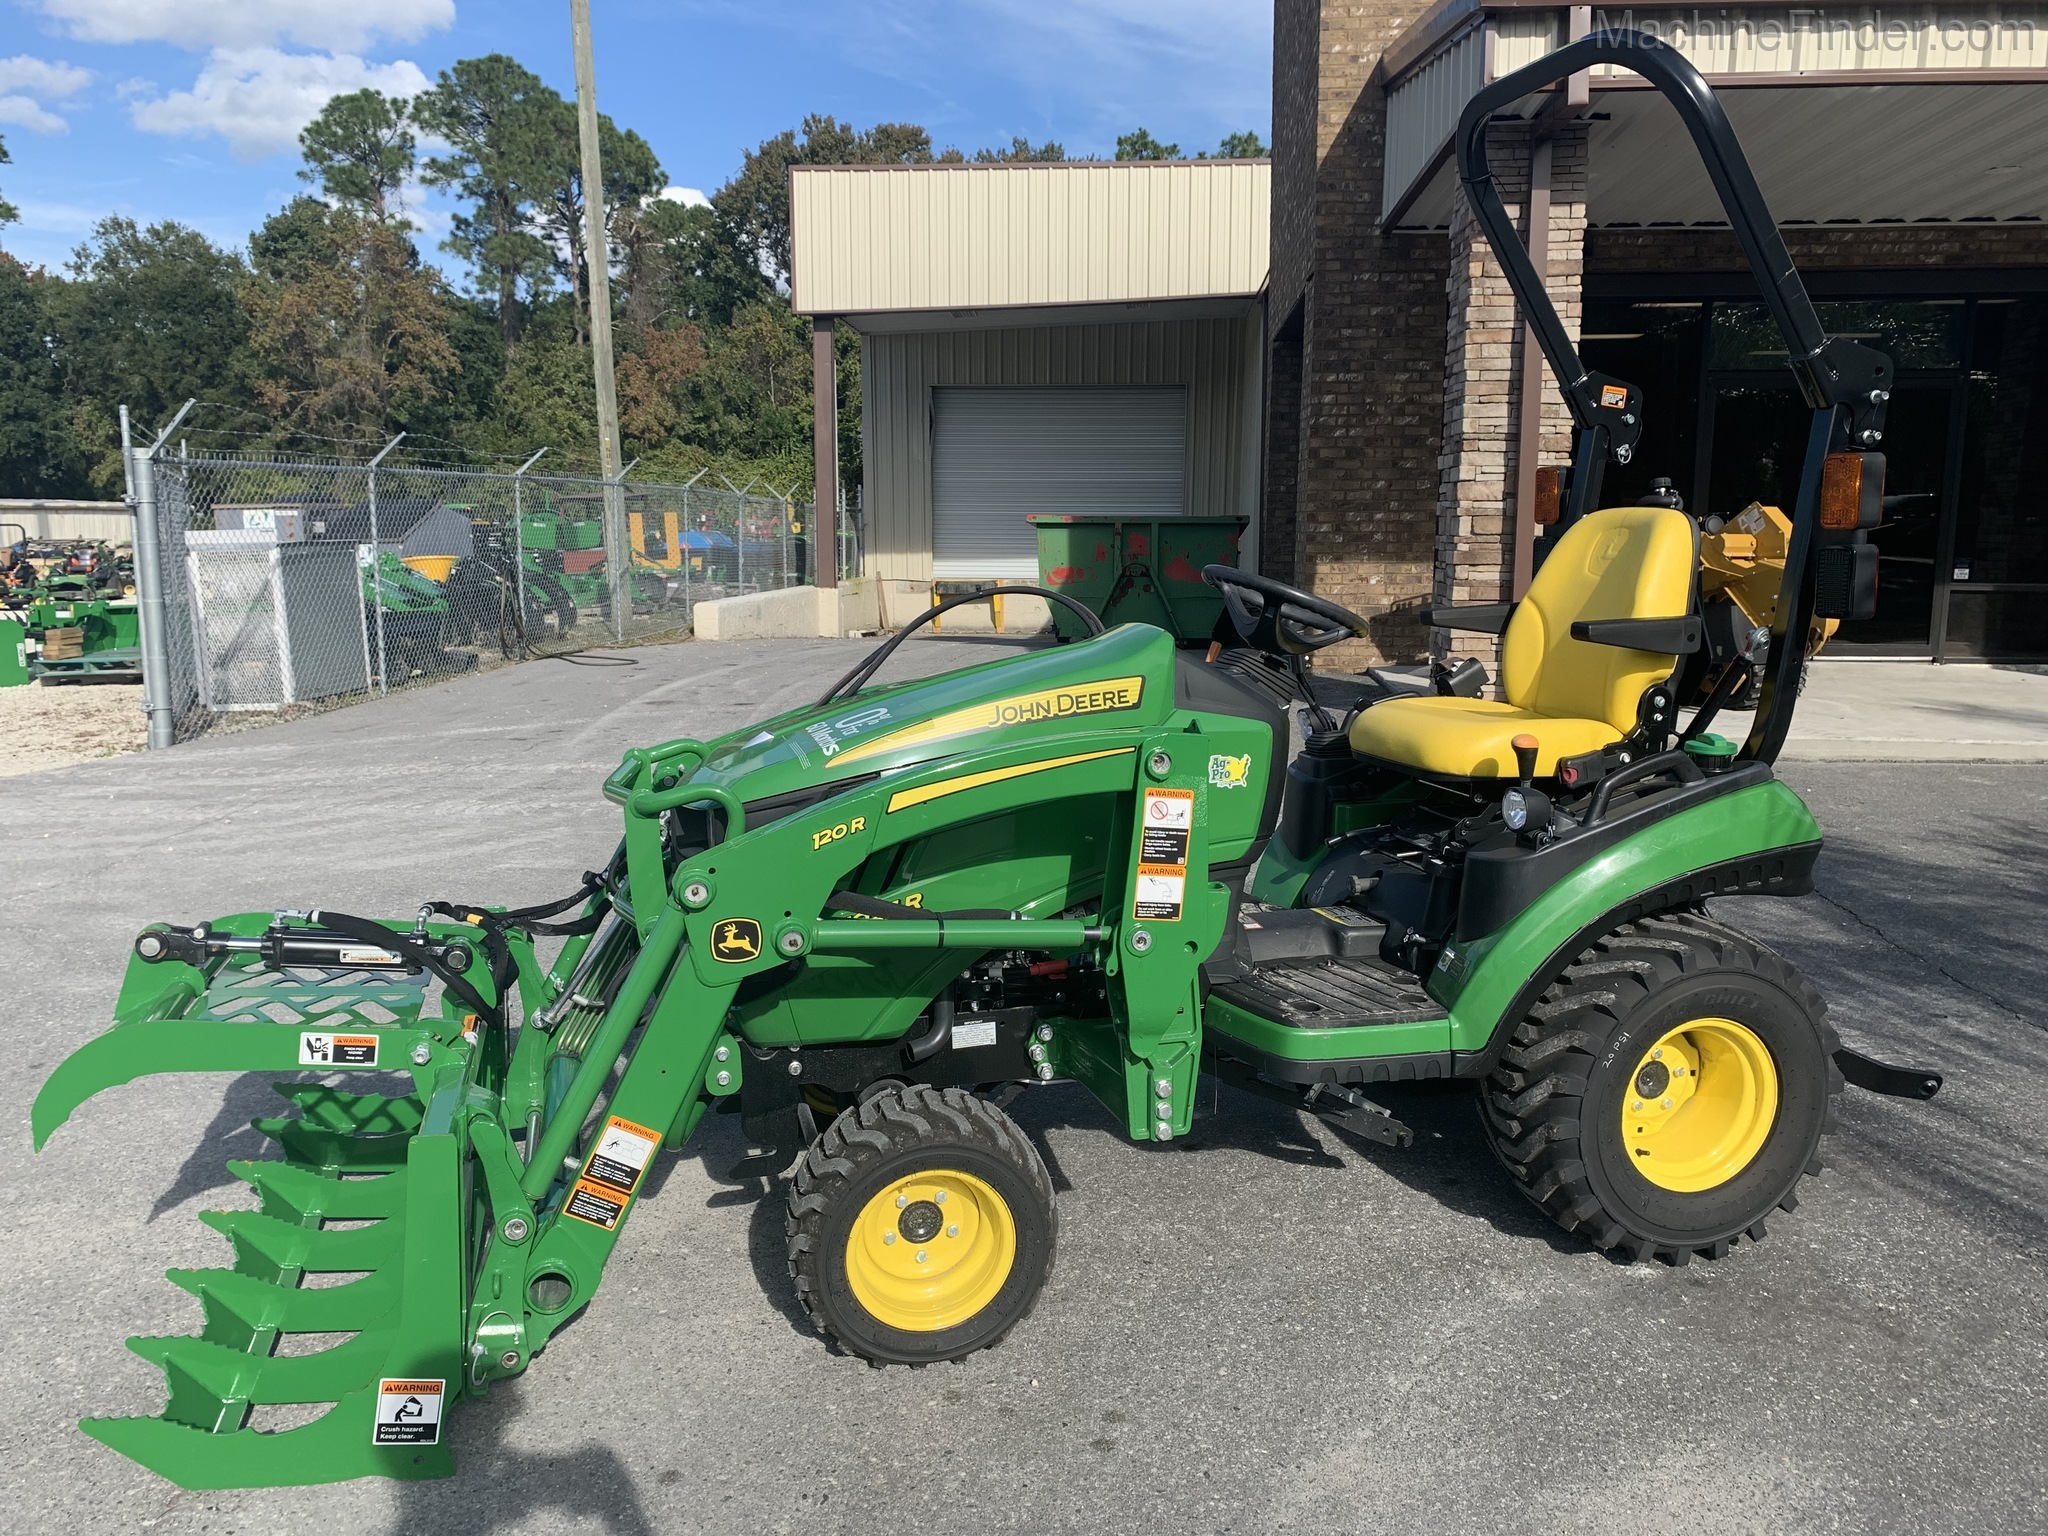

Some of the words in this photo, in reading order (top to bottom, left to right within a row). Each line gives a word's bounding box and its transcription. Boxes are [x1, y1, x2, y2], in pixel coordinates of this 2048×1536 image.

[988, 700, 1051, 726] JOHN
[1056, 689, 1130, 713] DEERE
[1211, 769, 1231, 780] Pro
[1155, 790, 1191, 799] WARNING
[1147, 867, 1184, 876] WARNING
[622, 1123, 655, 1139] WARNING
[590, 1186, 623, 1203] WARNING
[393, 1384, 440, 1392] WARNING
